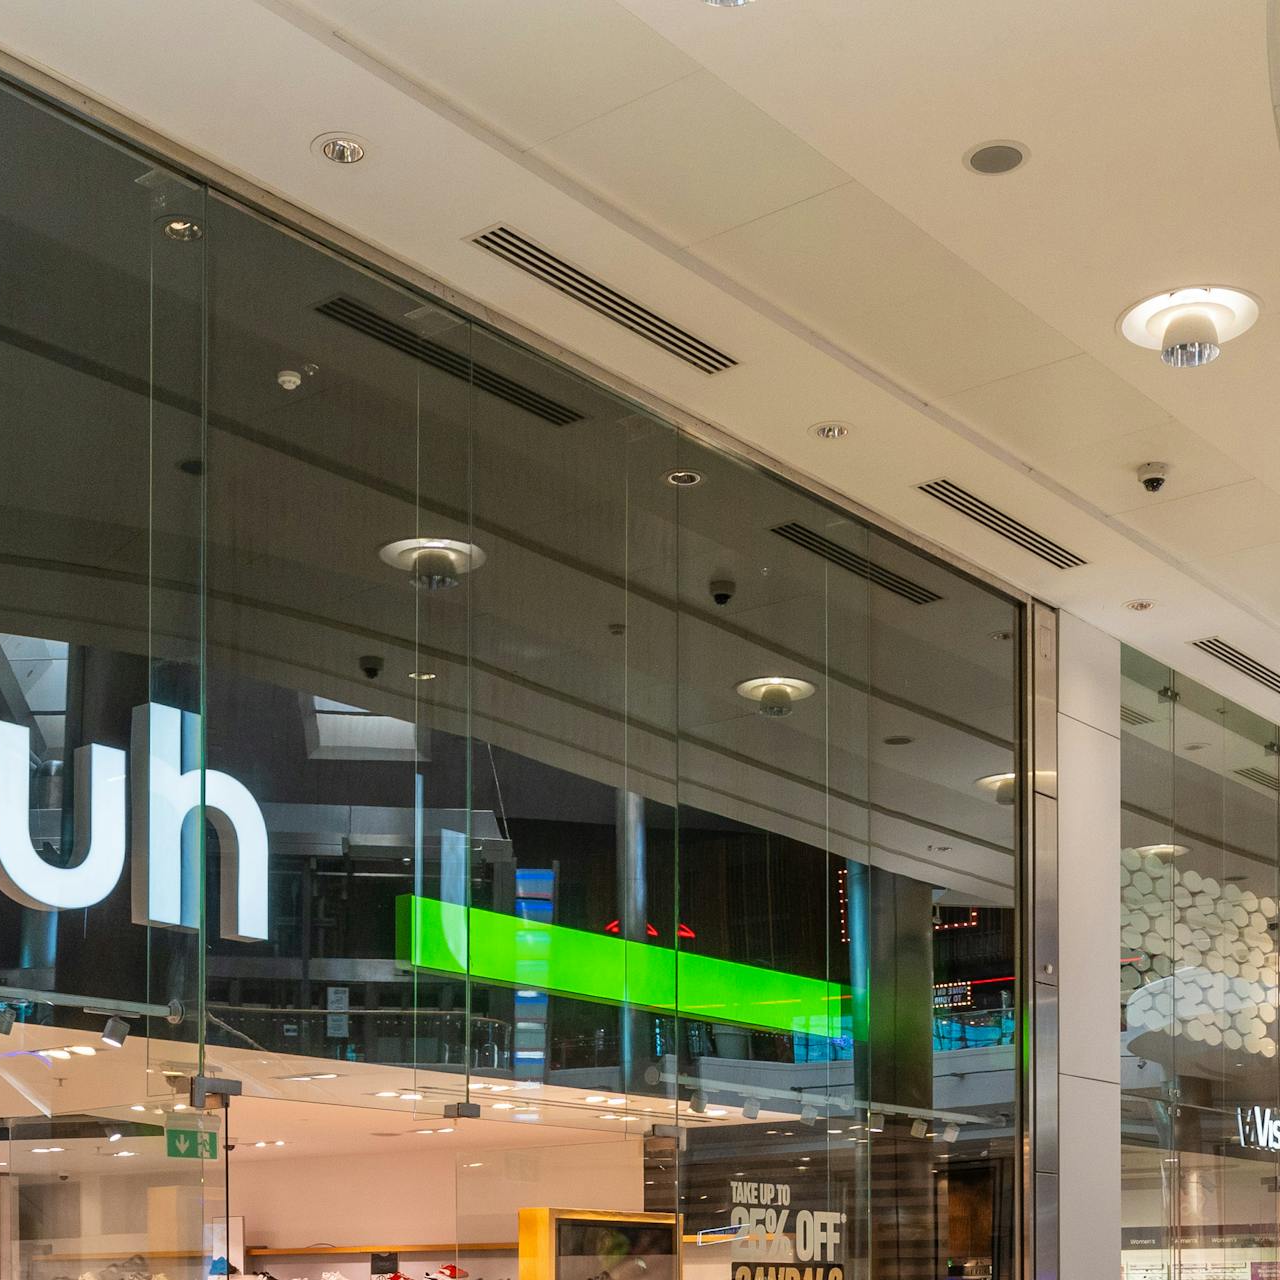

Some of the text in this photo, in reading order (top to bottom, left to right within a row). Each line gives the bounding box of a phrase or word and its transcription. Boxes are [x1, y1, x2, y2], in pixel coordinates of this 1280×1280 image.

[730, 1181, 791, 1206] TAKE UP TO
